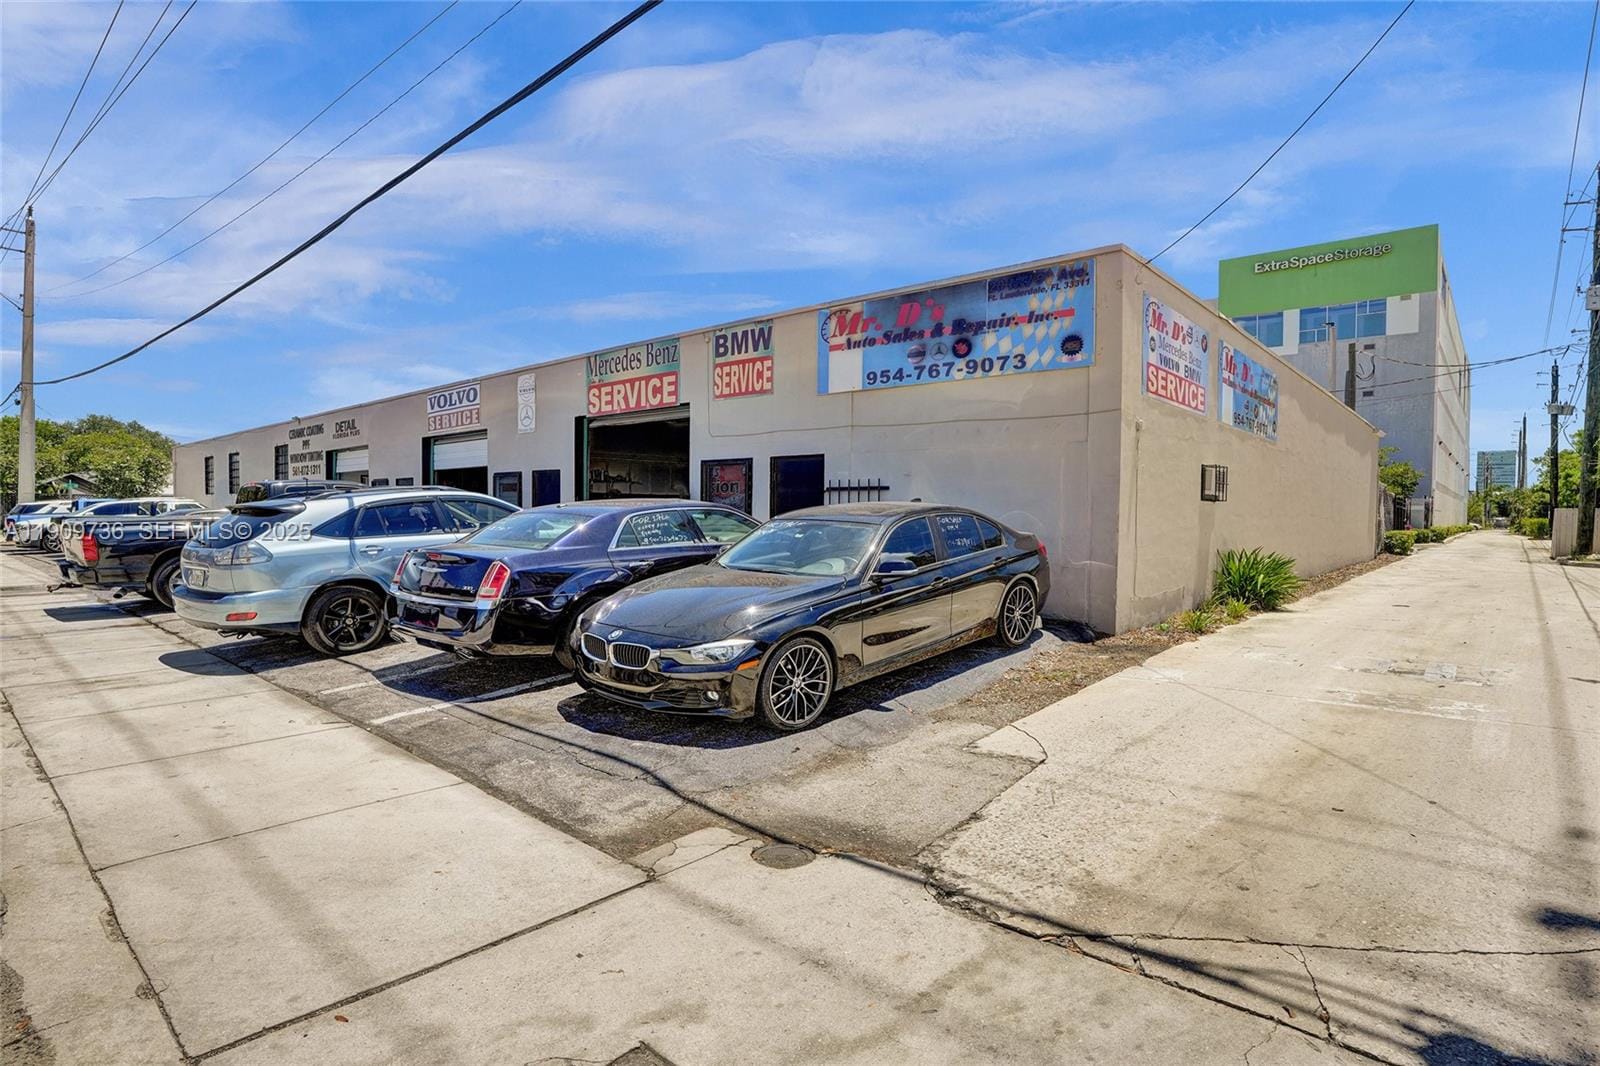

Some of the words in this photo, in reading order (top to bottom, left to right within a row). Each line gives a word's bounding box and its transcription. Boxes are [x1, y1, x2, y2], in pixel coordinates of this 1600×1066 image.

[831, 309, 884, 338] Mr.
[895, 298, 945, 329] D's
[843, 337, 877, 352] Auto
[882, 327, 925, 346] Sales
[930, 321, 945, 338] &
[1026, 310, 1059, 327] Inc.
[1150, 307, 1169, 336] Mr.
[1171, 320, 1187, 345] D's
[715, 326, 773, 358] BMW
[1158, 334, 1188, 361] Mercedes
[587, 347, 642, 378] Mercedes
[646, 343, 679, 367] Benz
[866, 353, 1027, 386] 954-767-9073
[1184, 364, 1201, 383] BMW
[588, 375, 677, 414] SERVICE
[714, 360, 772, 396] SERVICE
[1147, 364, 1205, 411] SERVICE
[428, 387, 478, 411] VOLVO
[335, 418, 357, 433] DETAIL
[428, 408, 479, 431] SERVICE
